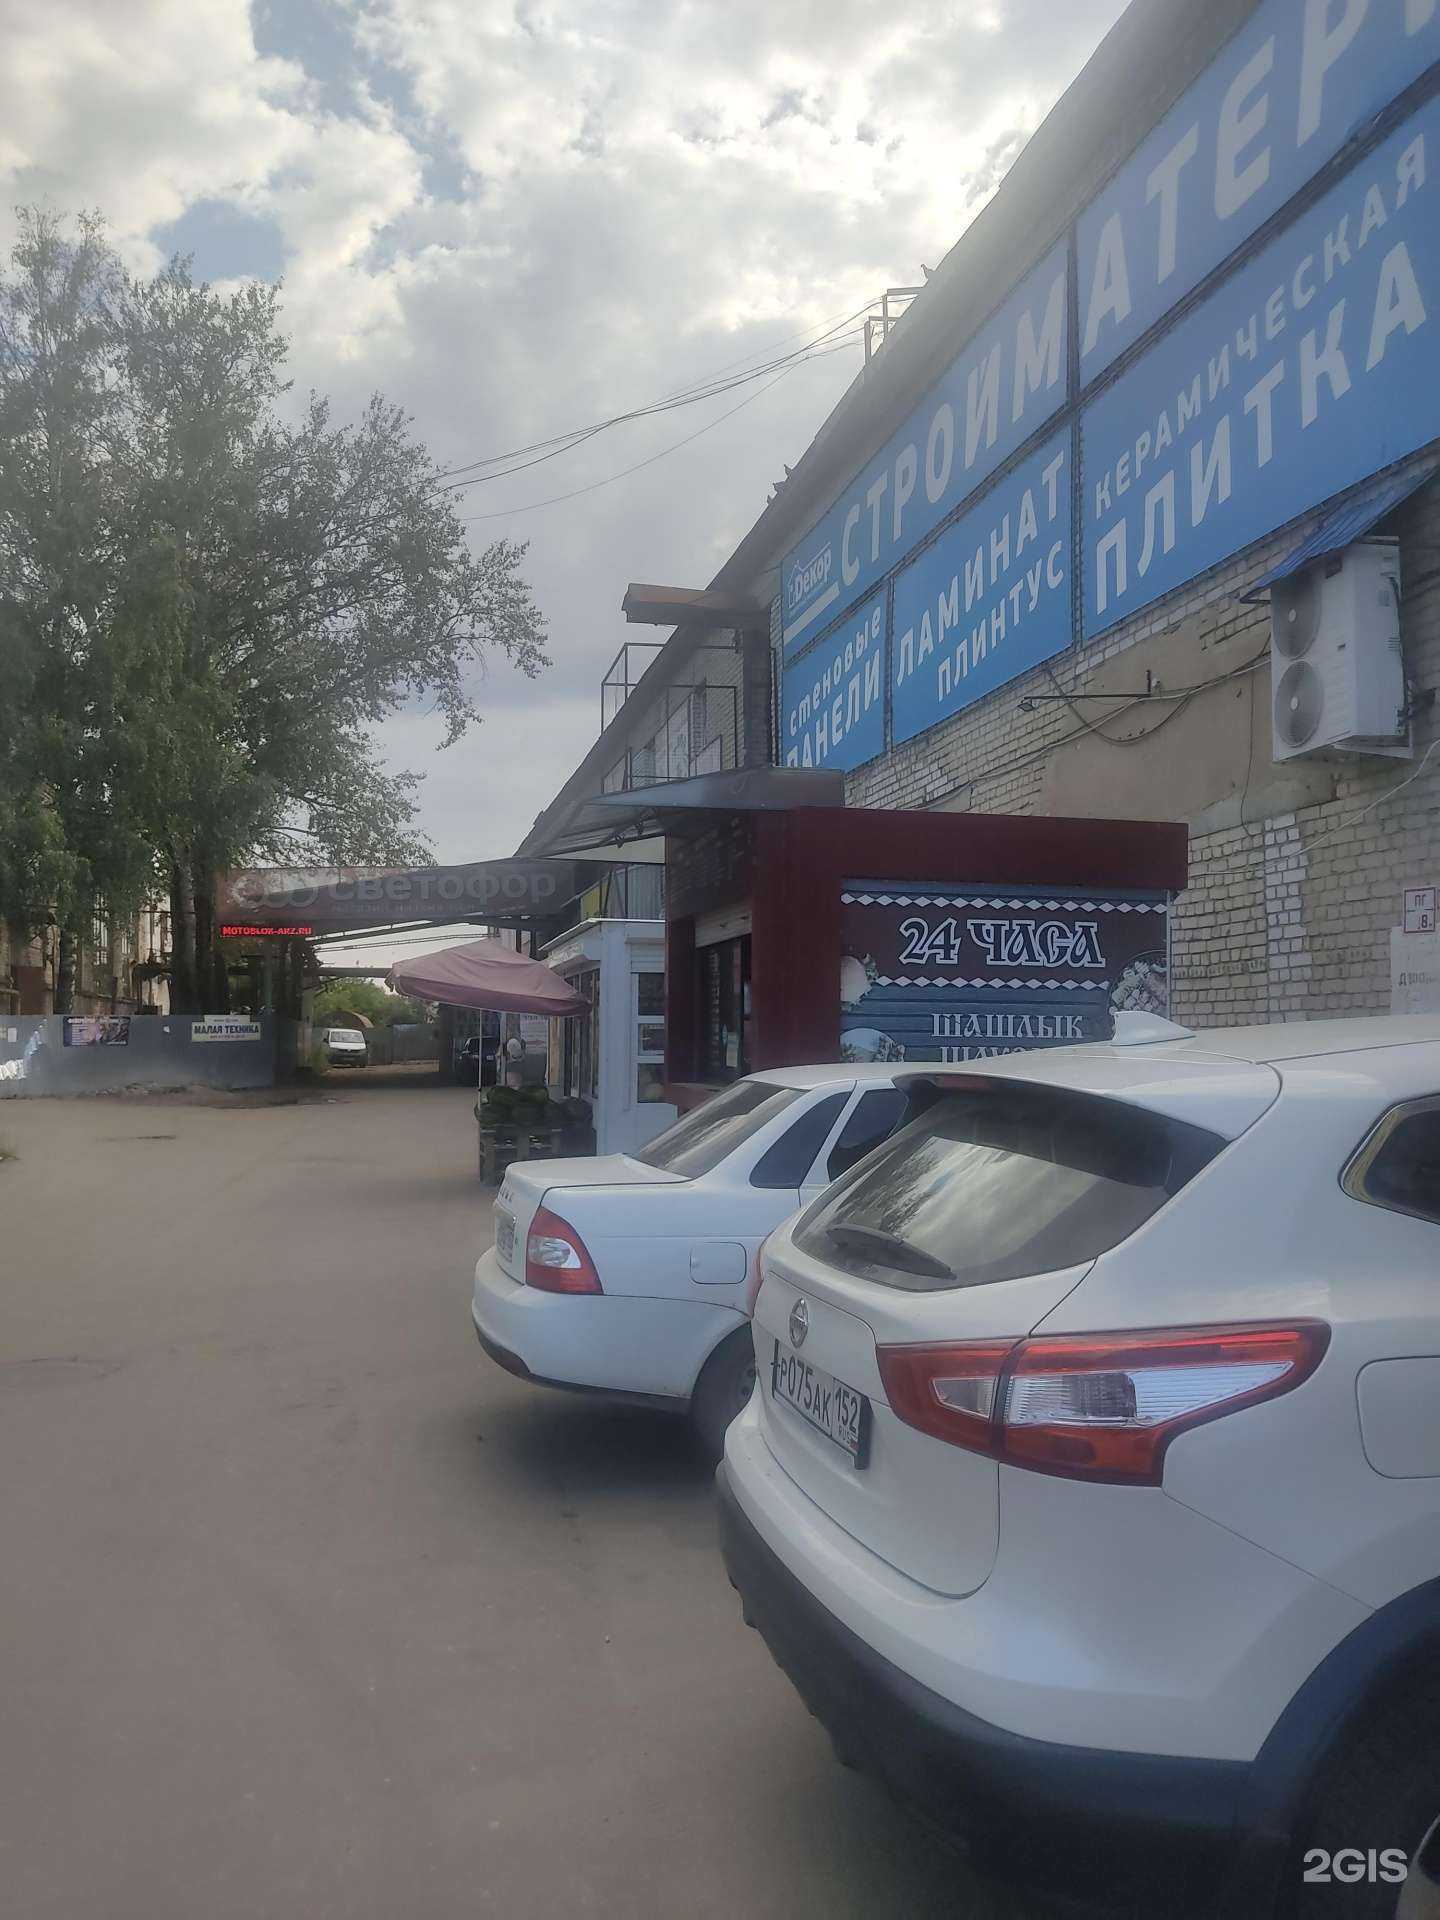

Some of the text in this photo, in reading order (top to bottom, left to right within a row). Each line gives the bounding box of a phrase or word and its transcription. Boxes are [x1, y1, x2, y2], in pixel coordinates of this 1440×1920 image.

[840, 0, 1436, 587] СТРОИМАТЕР
[1095, 132, 1426, 519] КЕРАМИЧЕСКАЯ
[1096, 241, 1427, 615] ПЛИТКА
[896, 450, 1064, 687] ЛАМИНАТ
[938, 541, 1064, 702] ПЛИНТУС
[787, 649, 880, 768] ПАНЕЛИ
[790, 607, 881, 737] стеновые
[899, 917, 1106, 968] 24 ЧАСА
[194, 1024, 260, 1034] МАЛАЯ ТЕХНИКА
[932, 1014, 1084, 1039] ШАШЛЫК
[835, 1386, 858, 1434] 152
